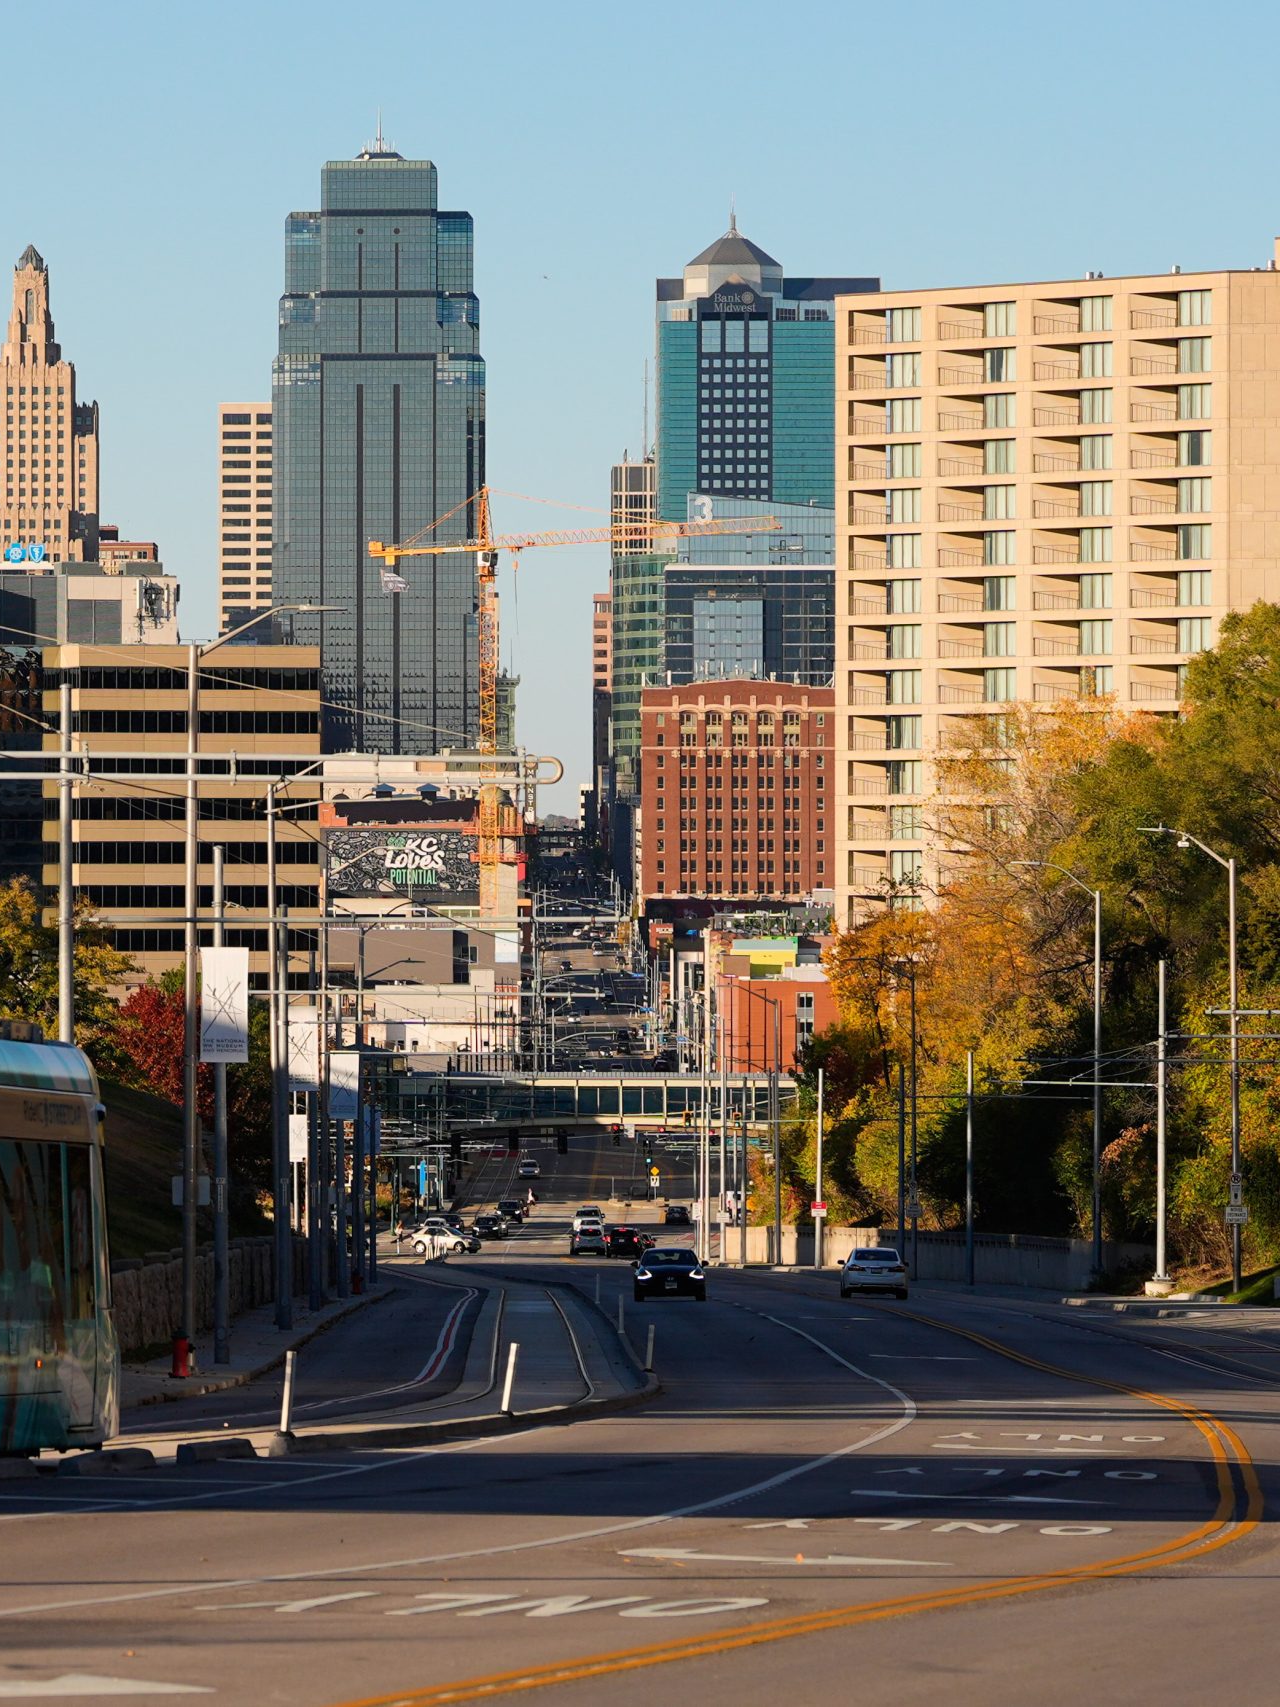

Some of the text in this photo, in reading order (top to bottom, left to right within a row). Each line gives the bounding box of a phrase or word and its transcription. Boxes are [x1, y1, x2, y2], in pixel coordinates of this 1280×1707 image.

[714, 293, 741, 302] Bank
[714, 303, 757, 312] Midwest
[694, 495, 713, 524] 3
[405, 838, 438, 855] KC
[390, 869, 437, 885] POTENTIAL
[937, 1432, 1166, 1442] ONLY
